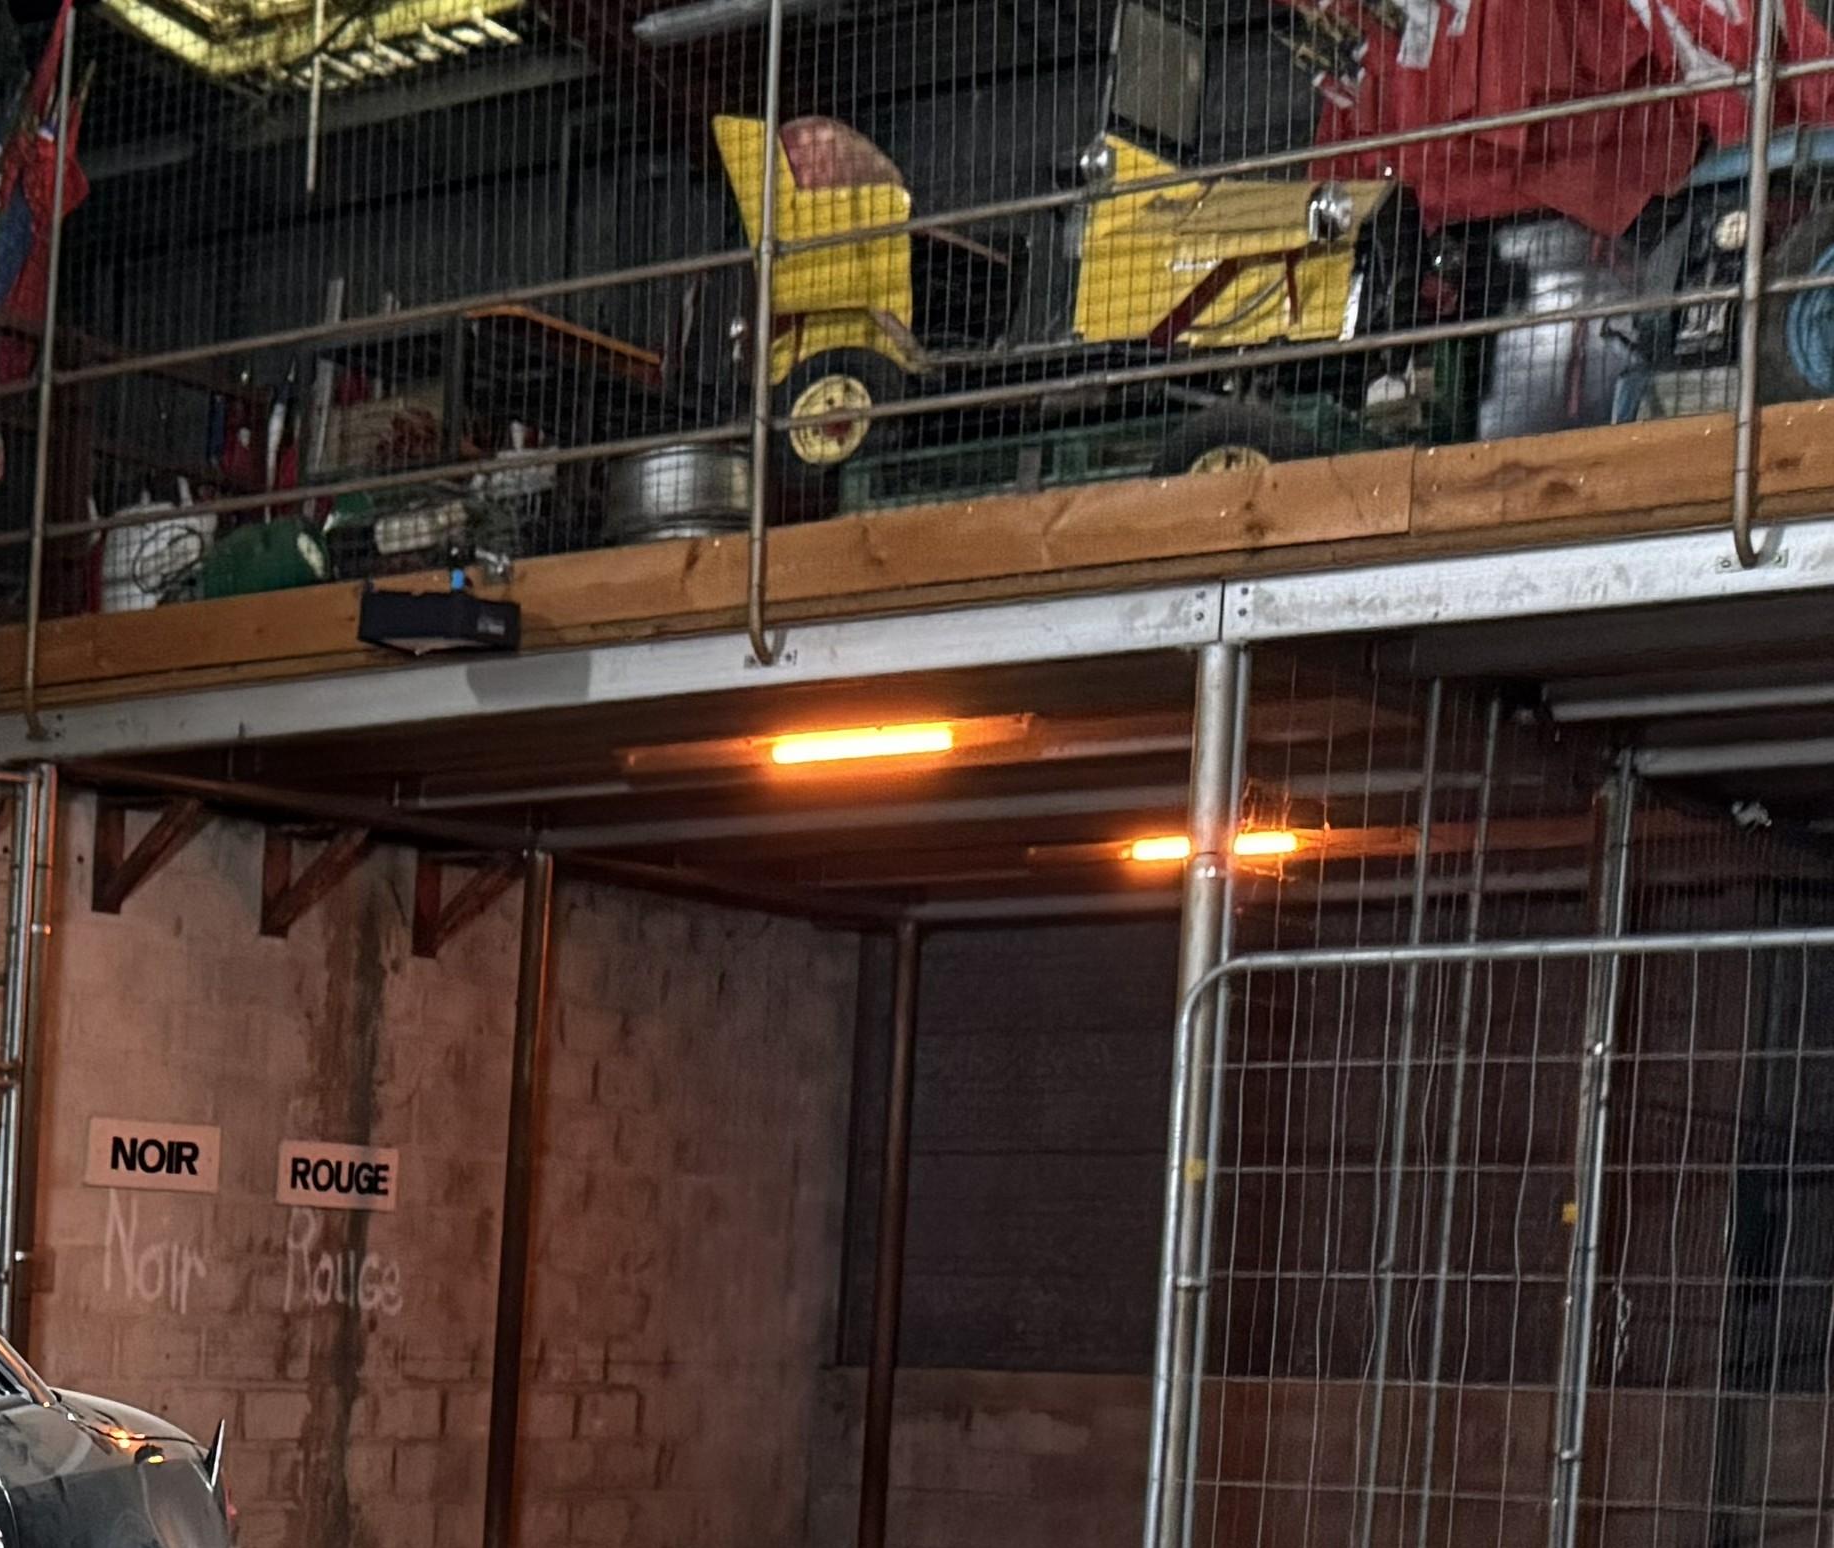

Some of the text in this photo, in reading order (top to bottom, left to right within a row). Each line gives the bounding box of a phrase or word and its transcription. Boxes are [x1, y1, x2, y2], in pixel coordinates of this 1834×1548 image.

[111, 1136, 199, 1176] NOIR
[290, 1157, 389, 1195] ROUGE
[104, 1189, 207, 1314] Noir
